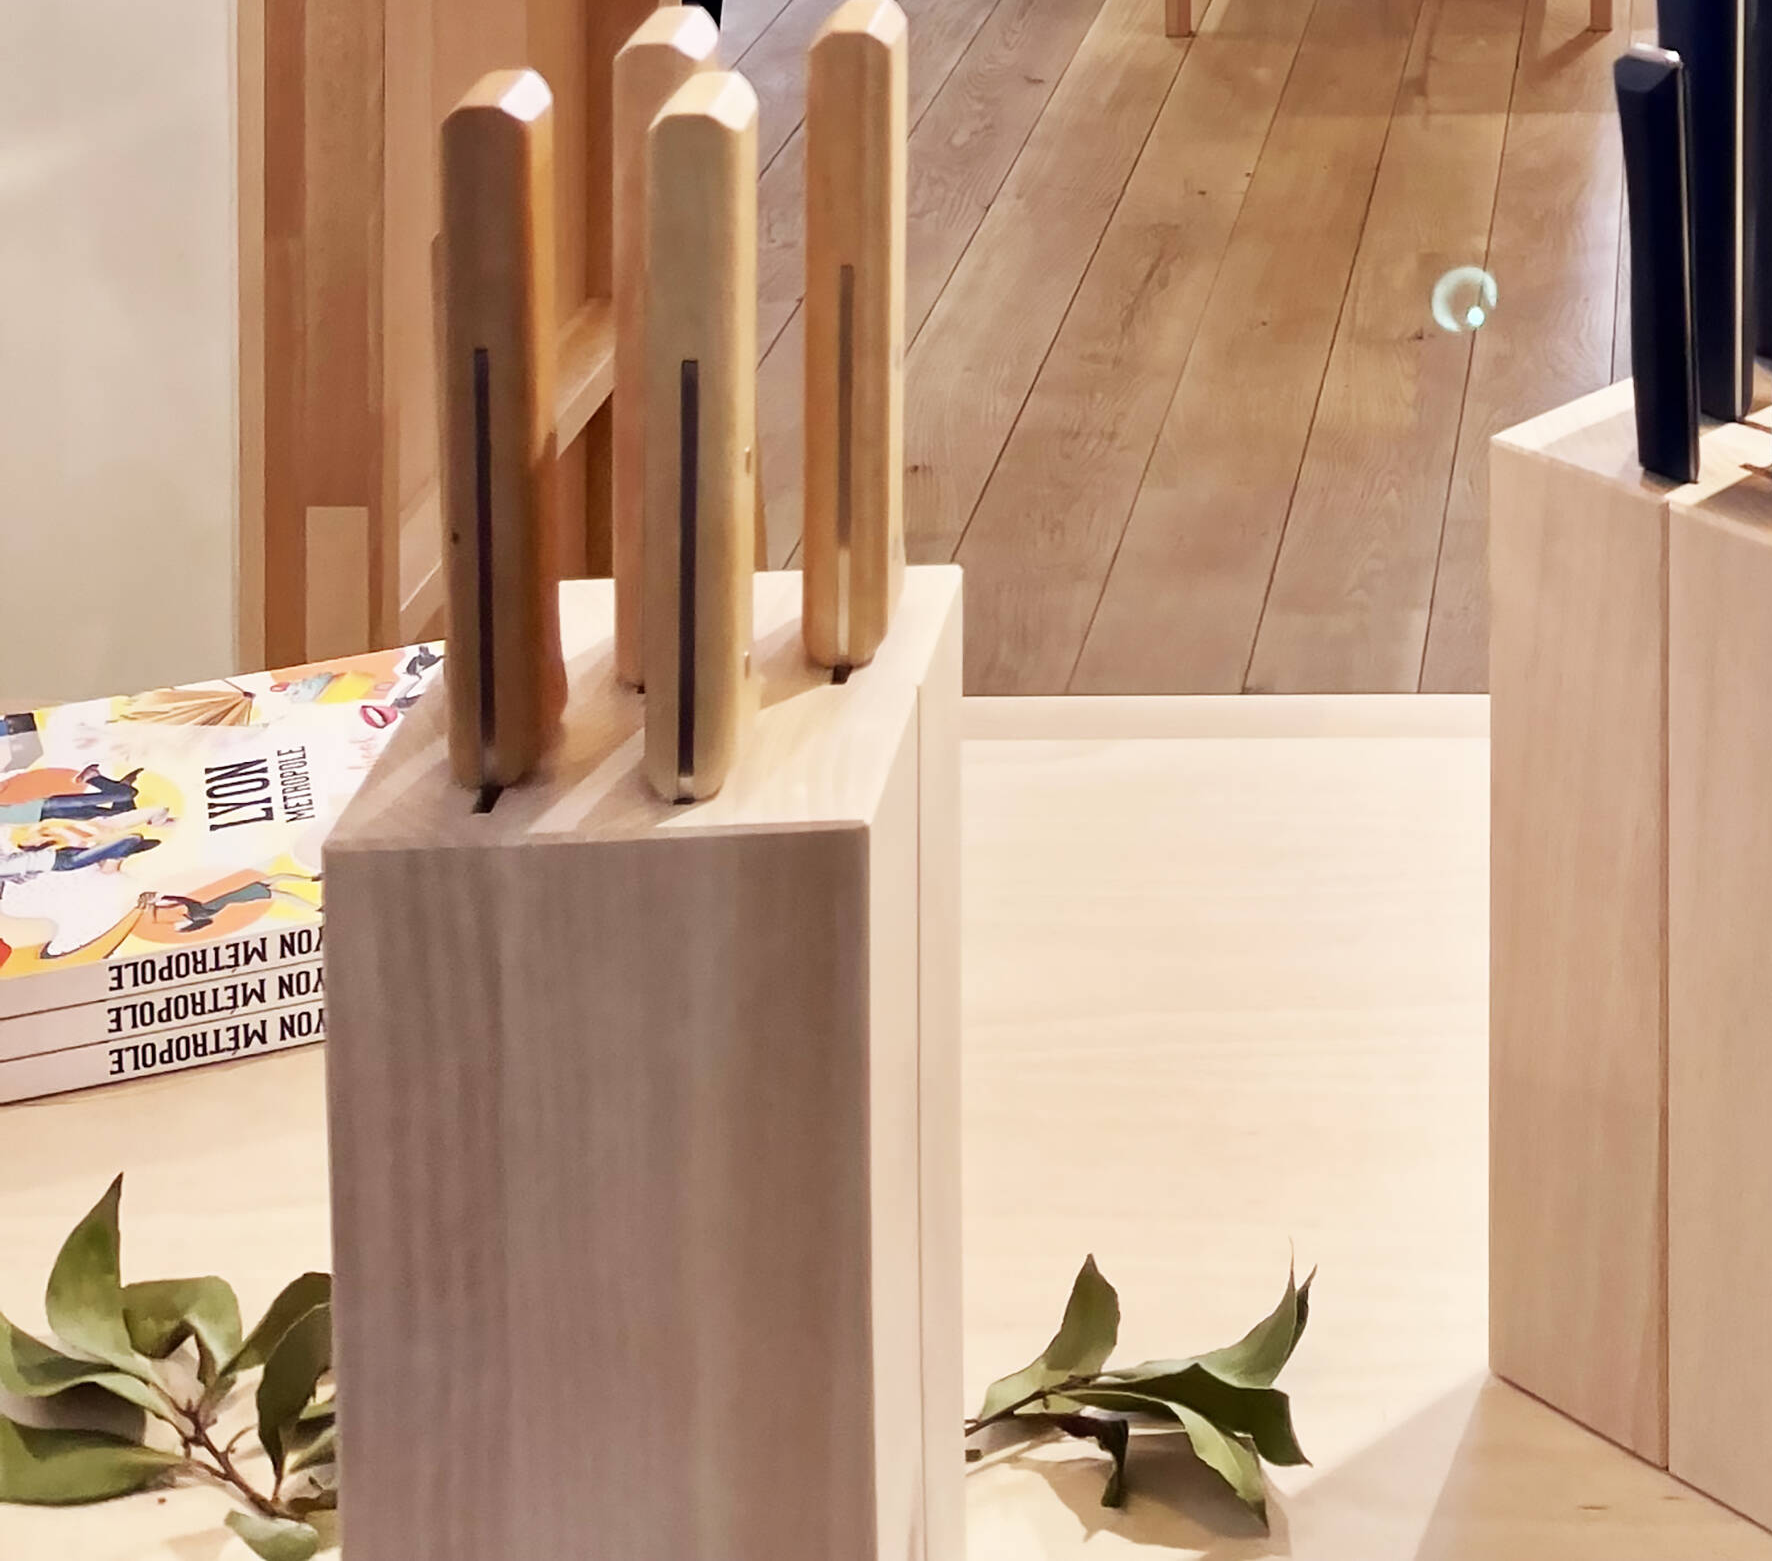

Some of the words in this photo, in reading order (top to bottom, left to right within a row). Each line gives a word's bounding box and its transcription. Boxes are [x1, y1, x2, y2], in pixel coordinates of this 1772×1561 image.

[204, 758, 275, 832] LYON
[109, 935, 267, 992] MÉTROPOLE
[107, 977, 266, 1034] MÉTROPOLE
[109, 1018, 267, 1076] MÉTROPOLE
